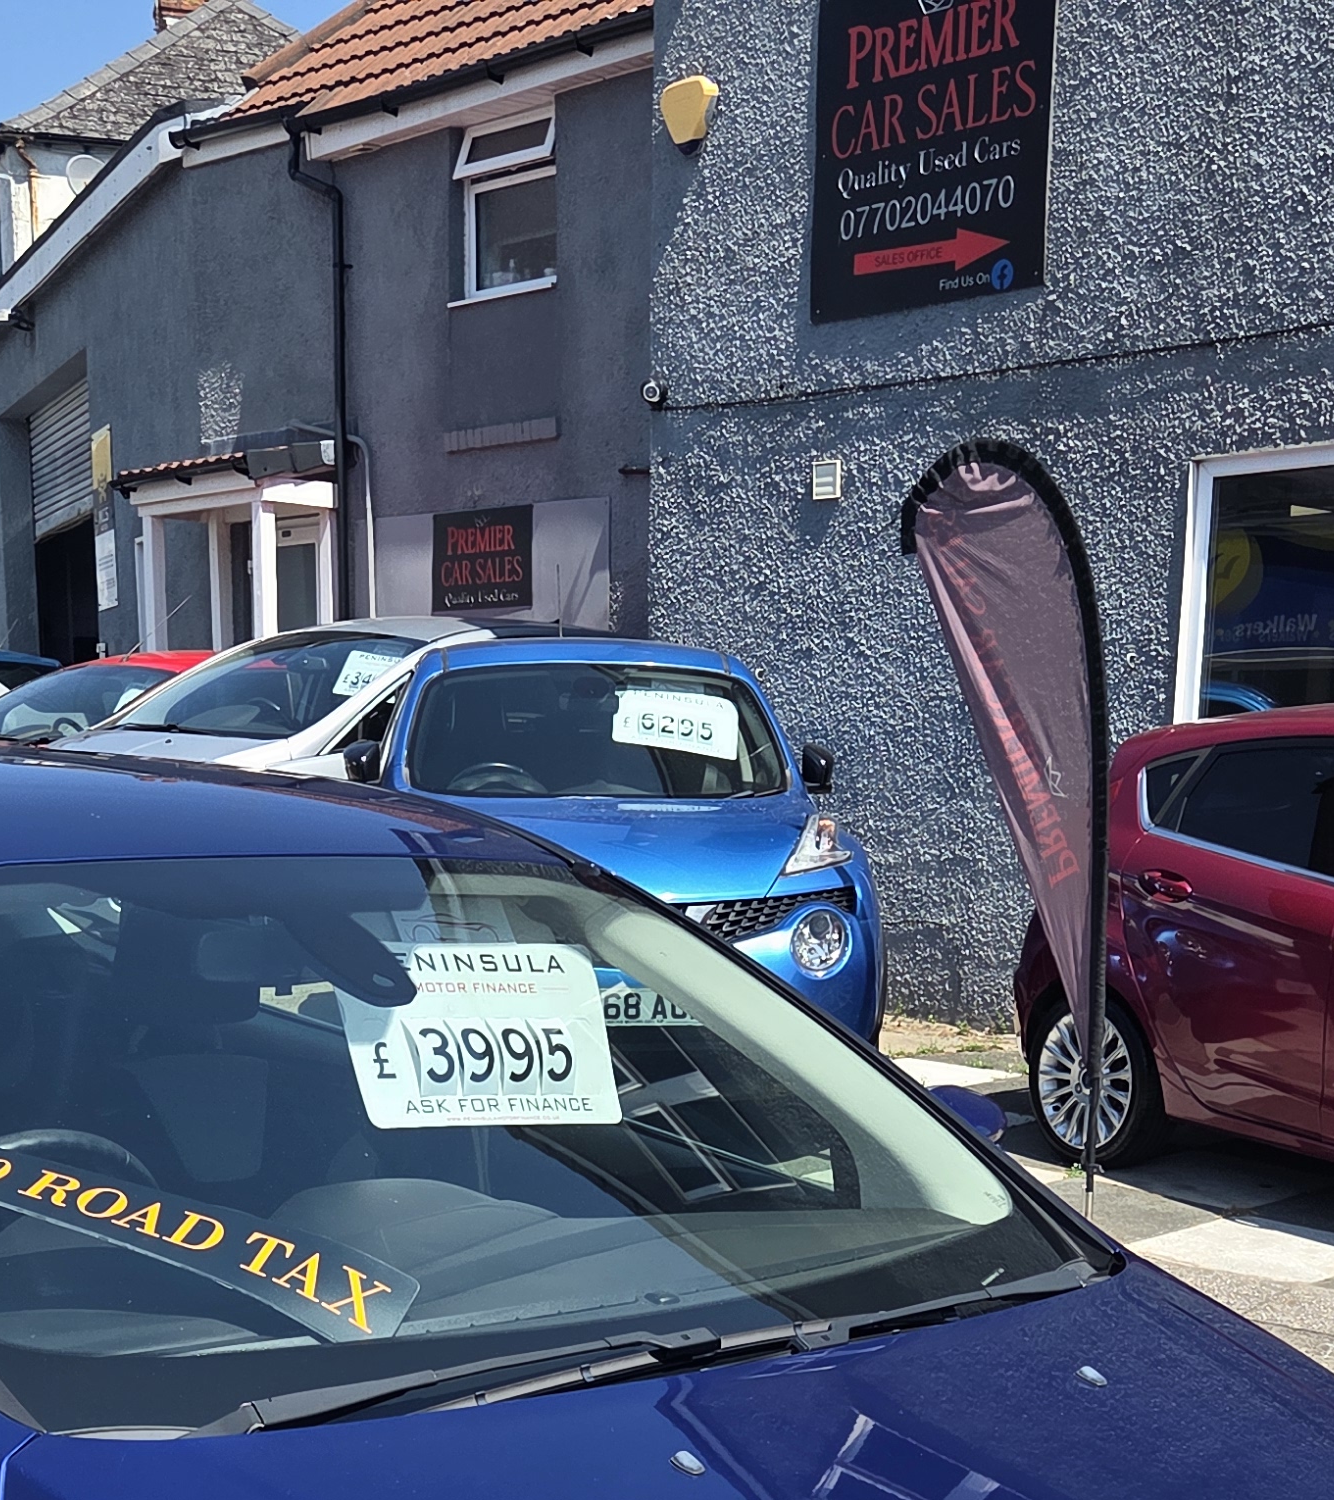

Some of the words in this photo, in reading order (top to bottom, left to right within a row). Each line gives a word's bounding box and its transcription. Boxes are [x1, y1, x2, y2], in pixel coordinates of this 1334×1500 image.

[846, 0, 1020, 89] PREMIER
[832, 94, 906, 159] CAR
[916, 60, 1037, 140] SALES
[838, 159, 911, 199] Quality
[919, 142, 967, 176] Used
[974, 136, 1021, 164] Cars
[840, 175, 1015, 241] 07702044070
[874, 252, 905, 267] SALES
[907, 246, 943, 262] OFFICE
[939, 276, 959, 290] Find
[447, 525, 515, 555] PREMIER
[441, 560, 472, 587] CAR
[475, 556, 523, 584] SALES
[359, 654, 401, 663] PENINSU
[641, 713, 713, 741] 6295
[394, 952, 565, 974] ENINSULA
[416, 982, 467, 994] MOTOR
[473, 982, 537, 995] FINANCE
[373, 1041, 397, 1079] £
[419, 1028, 573, 1083] 3995
[406, 1099, 451, 1114] ASK
[459, 1098, 501, 1112] FOR
[510, 1097, 593, 1112] FINANCE
[17, 1169, 226, 1252] ROAD
[240, 1231, 392, 1335] TAX
